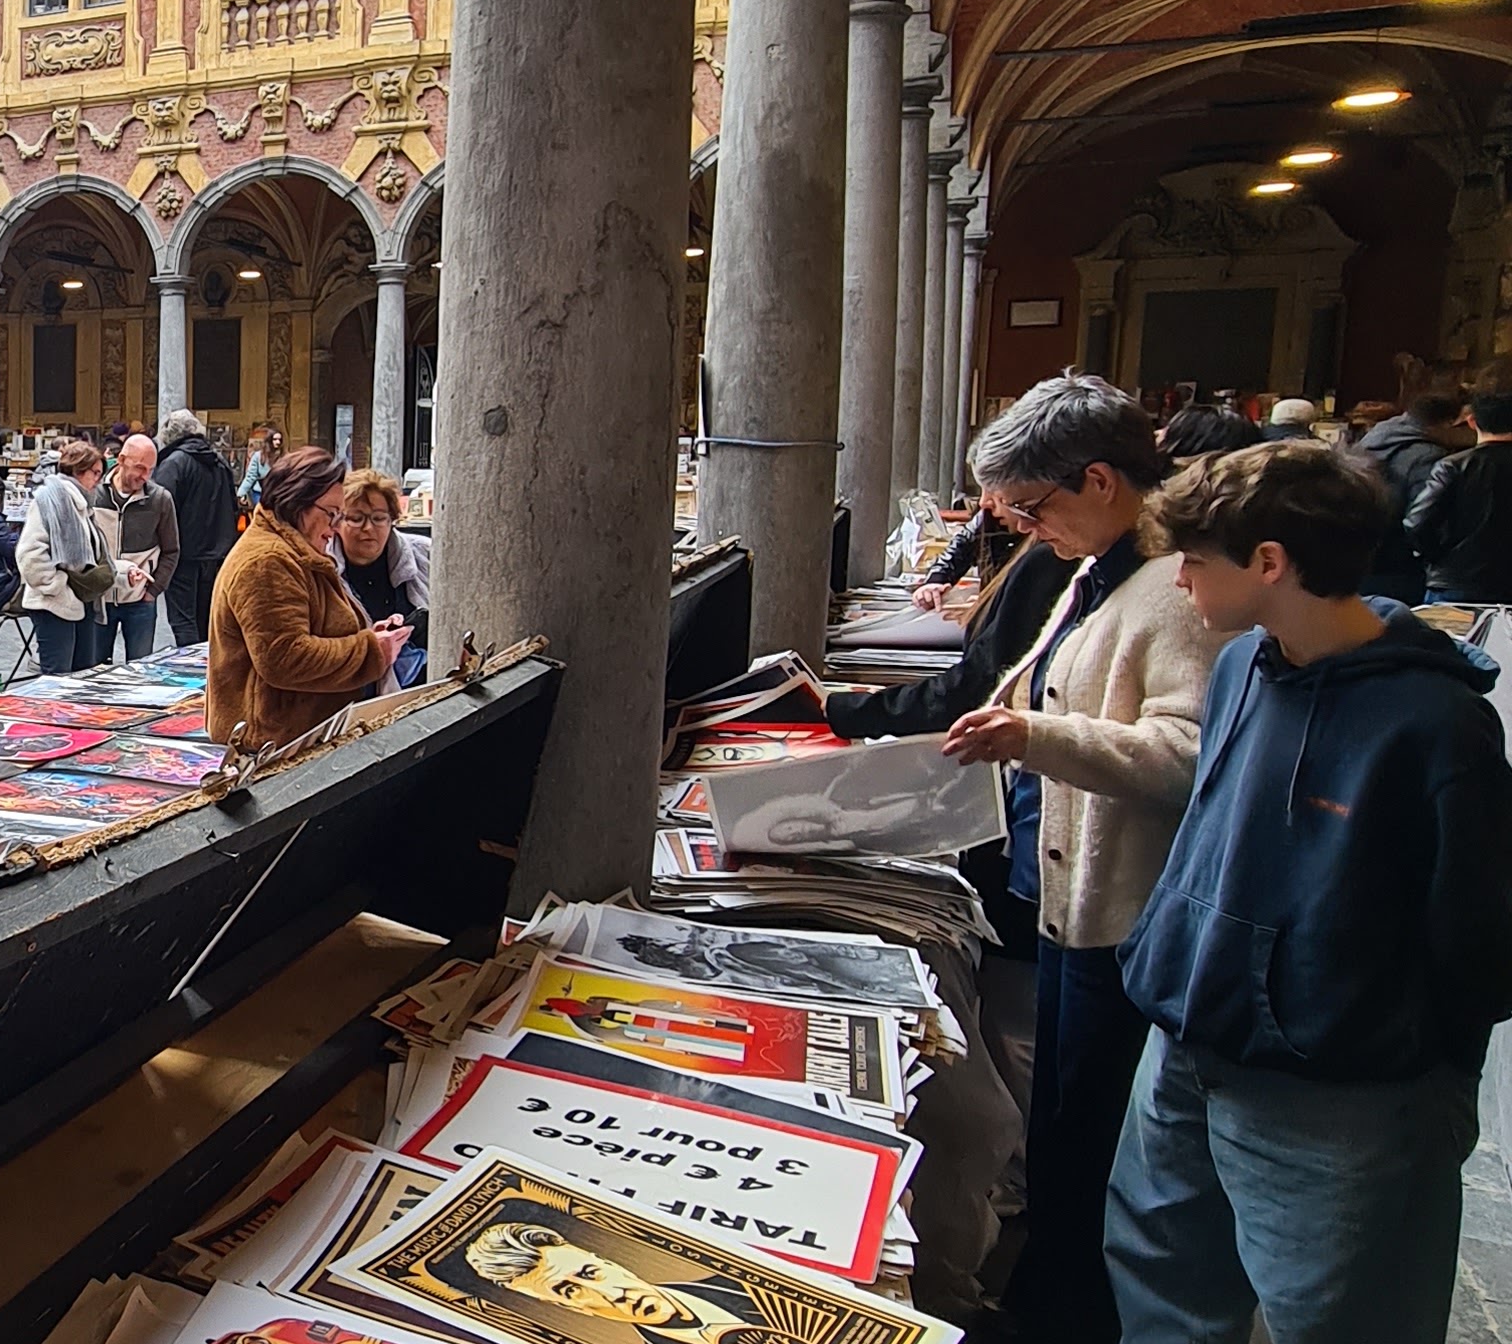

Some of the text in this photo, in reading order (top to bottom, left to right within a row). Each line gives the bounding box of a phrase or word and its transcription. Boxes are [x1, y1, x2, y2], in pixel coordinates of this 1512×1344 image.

[517, 1097, 810, 1177] 3 pour 10 €
[531, 1125, 774, 1193] 4 € pièce
[388, 1249, 416, 1270] THE
[411, 1229, 447, 1256] MUSIC
[446, 1203, 477, 1229] DAVID
[471, 1177, 507, 1210] LYNCH
[657, 1200, 828, 1251] TARIF
[651, 1238, 838, 1313] LOS ANGELES
